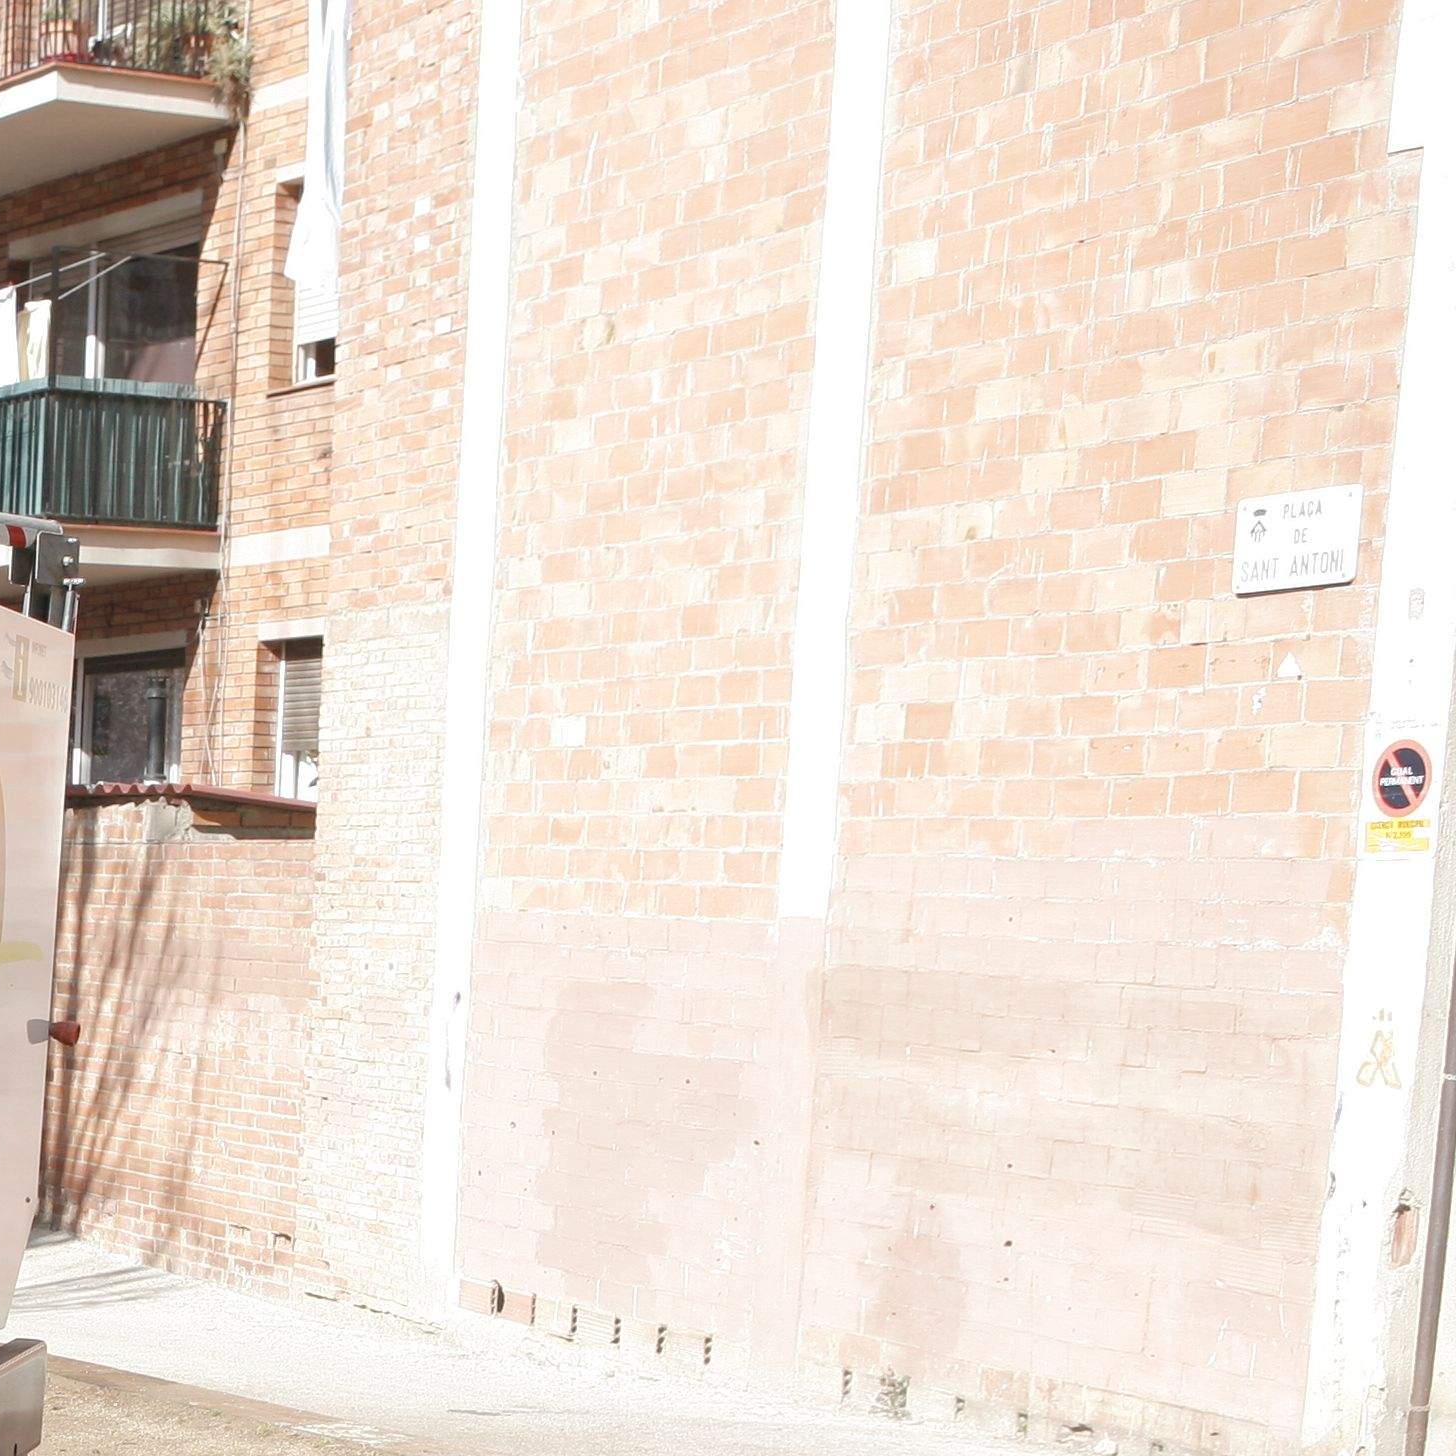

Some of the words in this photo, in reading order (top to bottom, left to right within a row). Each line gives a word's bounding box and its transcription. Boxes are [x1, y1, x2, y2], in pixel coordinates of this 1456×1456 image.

[1283, 499, 1323, 520] PLAÇA
[1293, 527, 1309, 545] DE
[1240, 557, 1280, 583] SANT
[1289, 549, 1344, 577] ANTONI
[1390, 766, 1414, 777] GUAL
